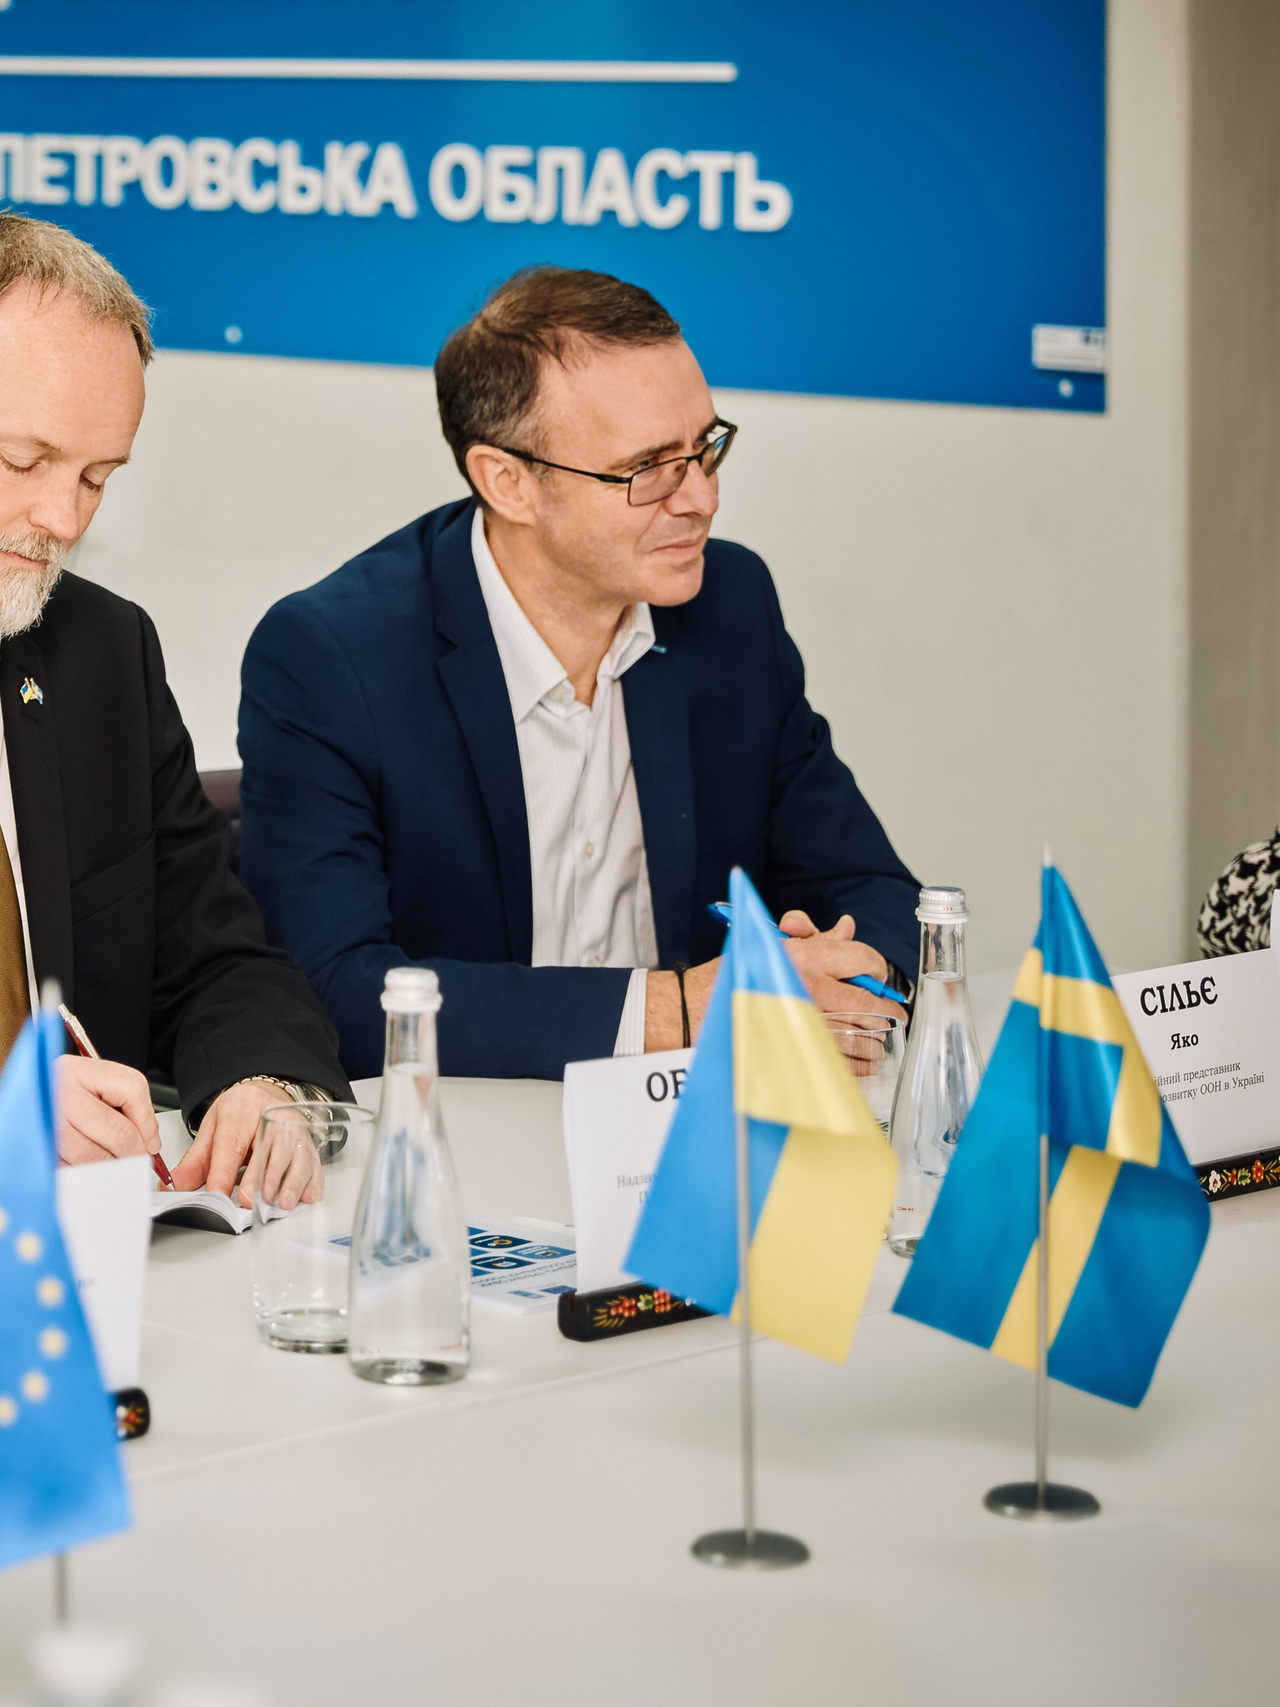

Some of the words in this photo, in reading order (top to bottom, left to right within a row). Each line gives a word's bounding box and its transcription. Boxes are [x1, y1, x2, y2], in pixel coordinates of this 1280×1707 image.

[428, 142, 793, 233] ОБЛАСТЬ
[1140, 976, 1218, 1016] СІЛЬЄ
[1171, 1033, 1199, 1050] Яко
[1153, 1071, 1181, 1088] ійний
[1183, 1062, 1241, 1083] представник
[1161, 1088, 1198, 1103] озвитку
[1200, 1080, 1222, 1096] ООН
[1224, 1080, 1230, 1091] в
[1232, 1071, 1265, 1090] Україні
